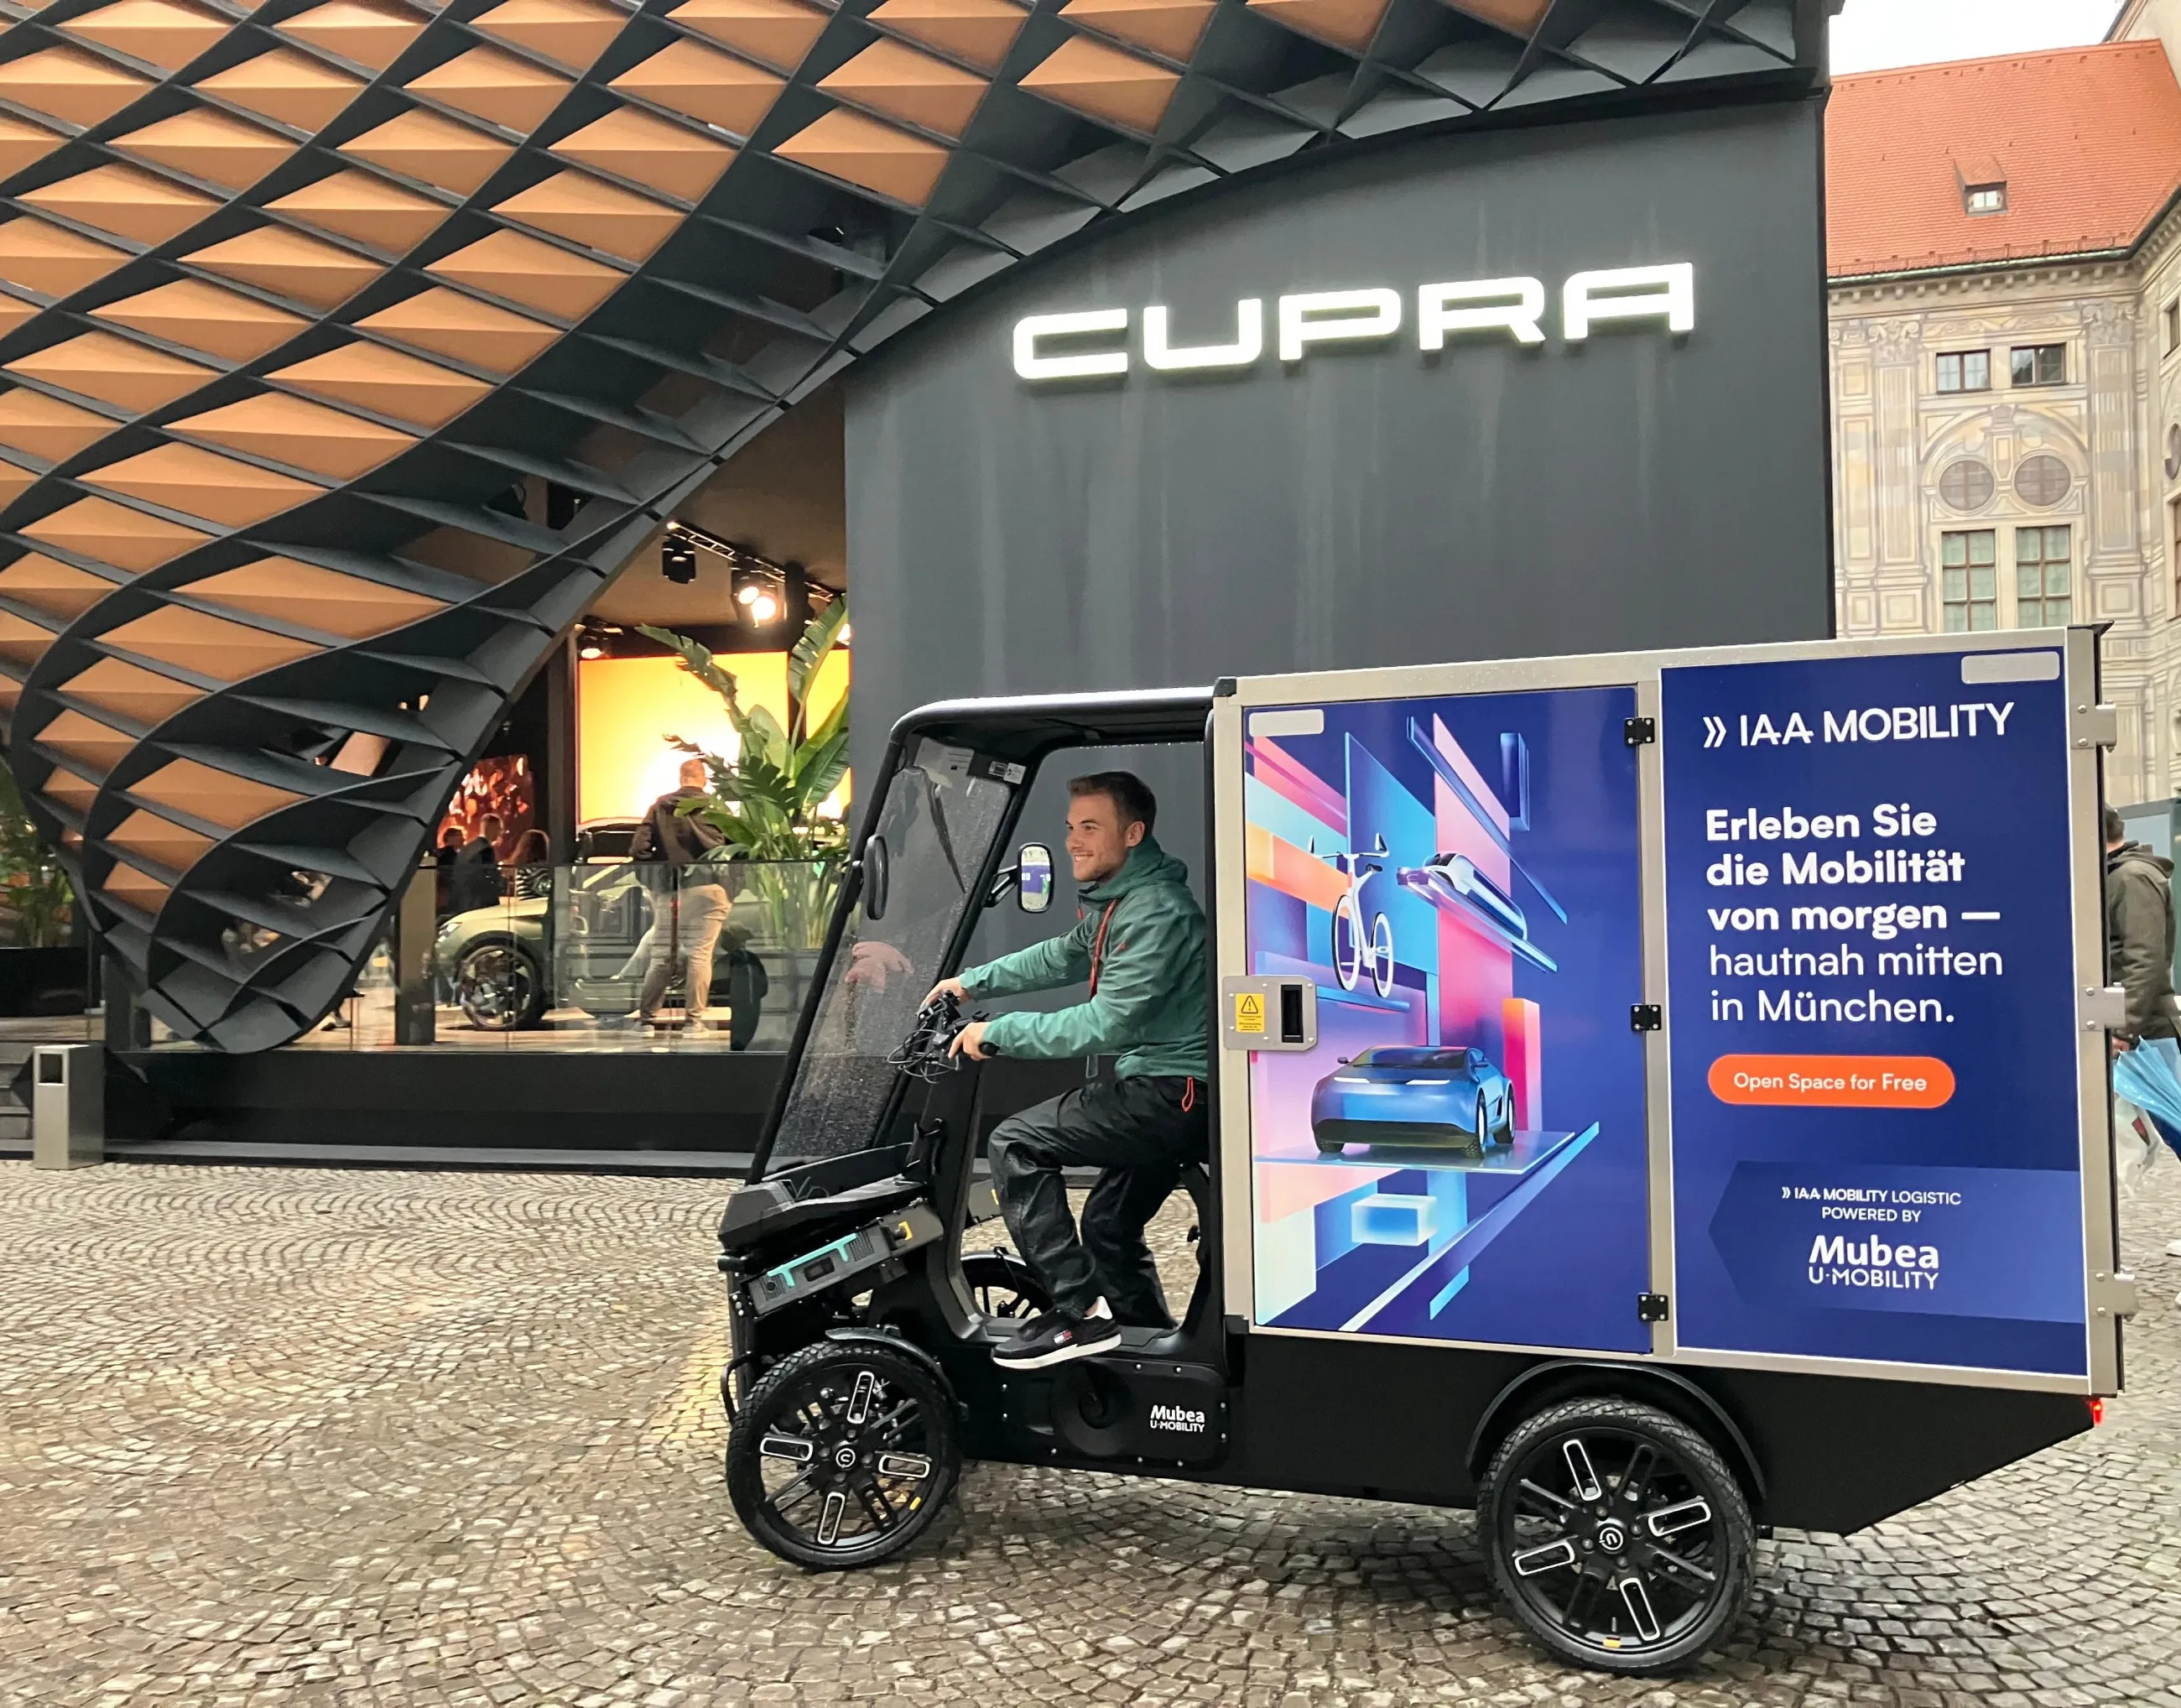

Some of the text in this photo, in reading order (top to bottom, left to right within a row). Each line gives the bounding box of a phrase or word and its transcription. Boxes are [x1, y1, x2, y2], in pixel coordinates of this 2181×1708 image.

[1013, 262, 1694, 379] CUPRA
[1740, 701, 2015, 747] IAA MOBILITY
[1706, 803, 1937, 841] Erleben Sie
[1706, 849, 1965, 887] die Mobilität
[1707, 907, 1779, 931] von
[1791, 903, 1947, 940] morgen
[1710, 943, 2002, 976] hautnah mitten
[1711, 988, 1955, 1023] in München.
[1733, 1072, 1928, 1094] Open Space for Free
[1794, 1187, 1961, 1205] IAA MOBILITY LOGISTIC
[1822, 1206, 1922, 1222] POWERED BY
[1809, 1234, 1939, 1269] Mubea
[1150, 1404, 1205, 1423] Mubea
